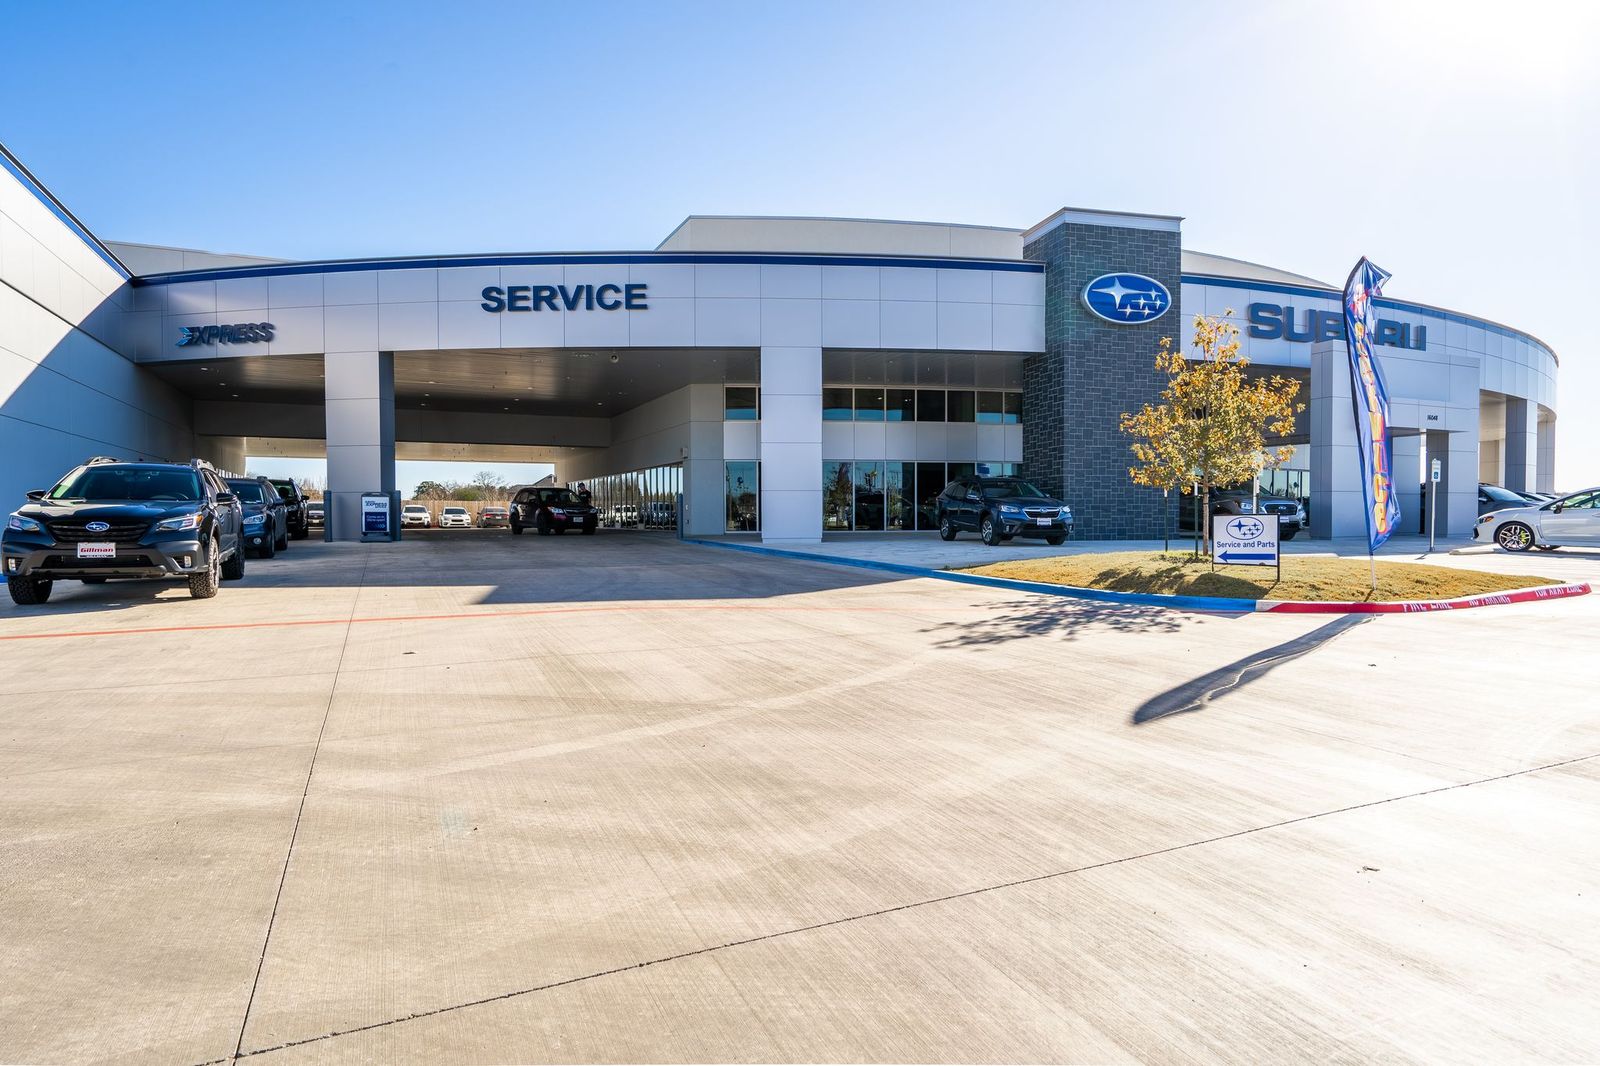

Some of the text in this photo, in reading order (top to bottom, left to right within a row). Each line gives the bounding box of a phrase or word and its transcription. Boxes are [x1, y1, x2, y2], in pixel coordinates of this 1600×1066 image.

[480, 283, 648, 314] SERVICE
[175, 321, 276, 347] EXPRESS
[1248, 302, 1427, 352] SUBRU
[1216, 540, 1276, 549] Service and Parts
